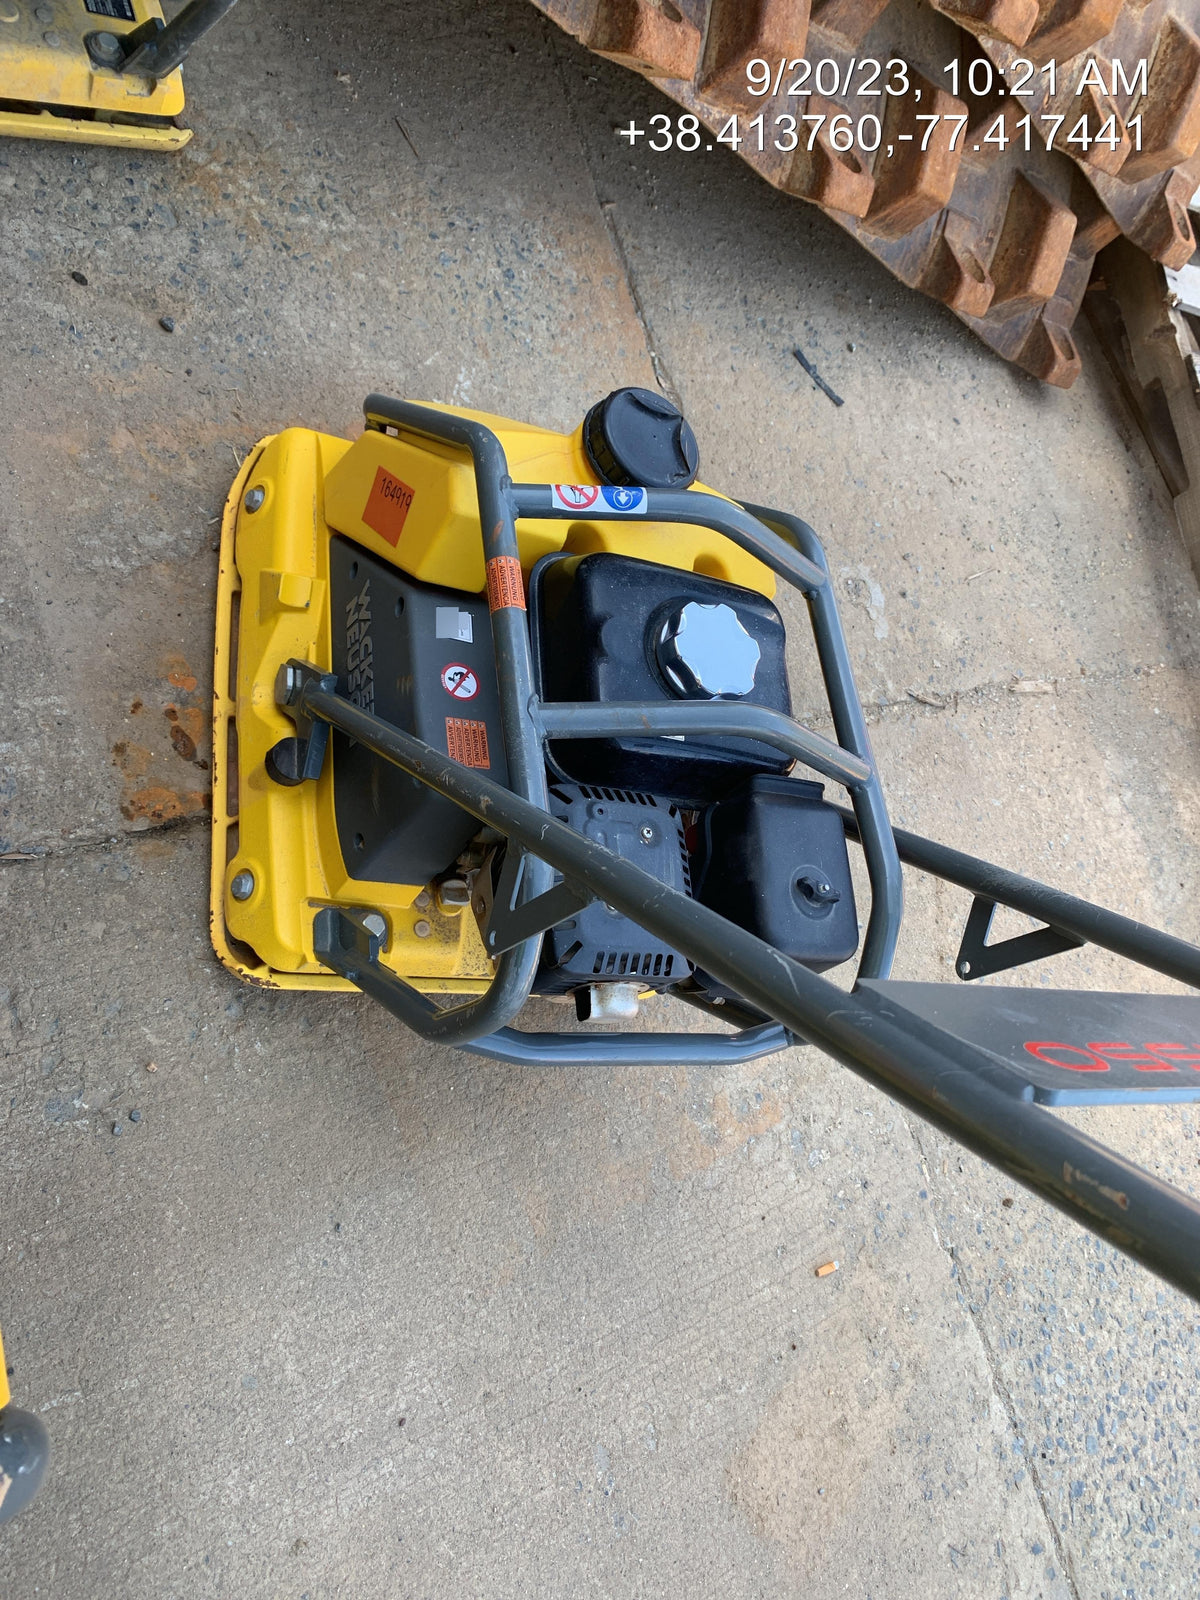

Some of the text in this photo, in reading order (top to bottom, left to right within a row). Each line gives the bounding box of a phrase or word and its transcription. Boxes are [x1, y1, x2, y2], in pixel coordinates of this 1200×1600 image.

[380, 477, 412, 513] 164919
[499, 565, 510, 607] ADVERTENCIA
[509, 565, 518, 601] WARNUNG
[463, 727, 473, 767] ADVERTENCIA
[471, 728, 480, 762] WARNUNG
[479, 729, 488, 760] WARNING
[1023, 1041, 1200, 1072] 550
